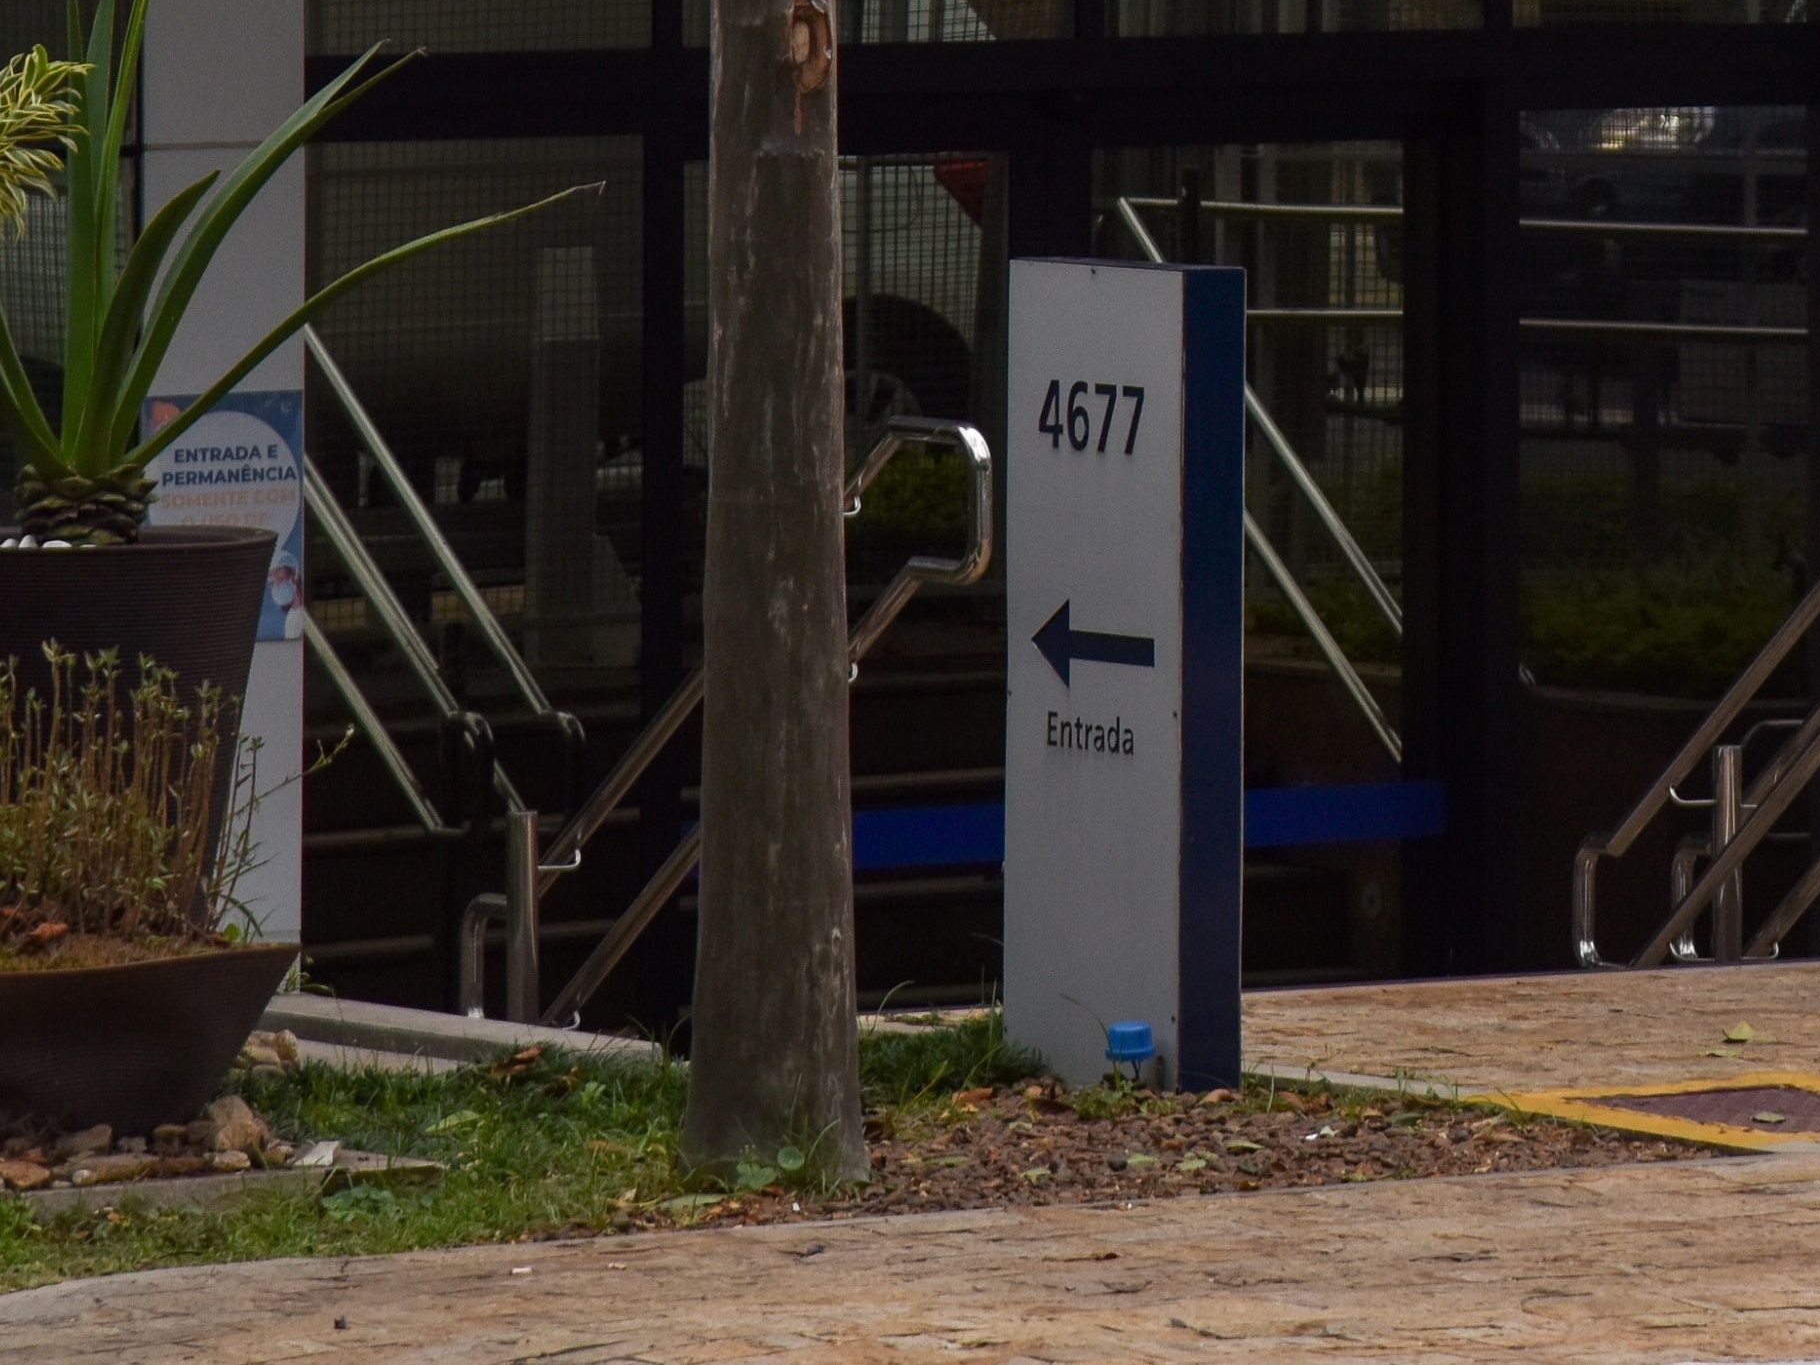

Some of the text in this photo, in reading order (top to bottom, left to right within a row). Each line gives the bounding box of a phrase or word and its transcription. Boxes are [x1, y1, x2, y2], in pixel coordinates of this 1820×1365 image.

[1038, 379, 1146, 455] 4677
[174, 443, 279, 463] ENTRADA E
[162, 464, 297, 487] PERMANÊNCIA
[161, 489, 296, 511] SOMENTE COM
[1046, 710, 1135, 756] Entrada
